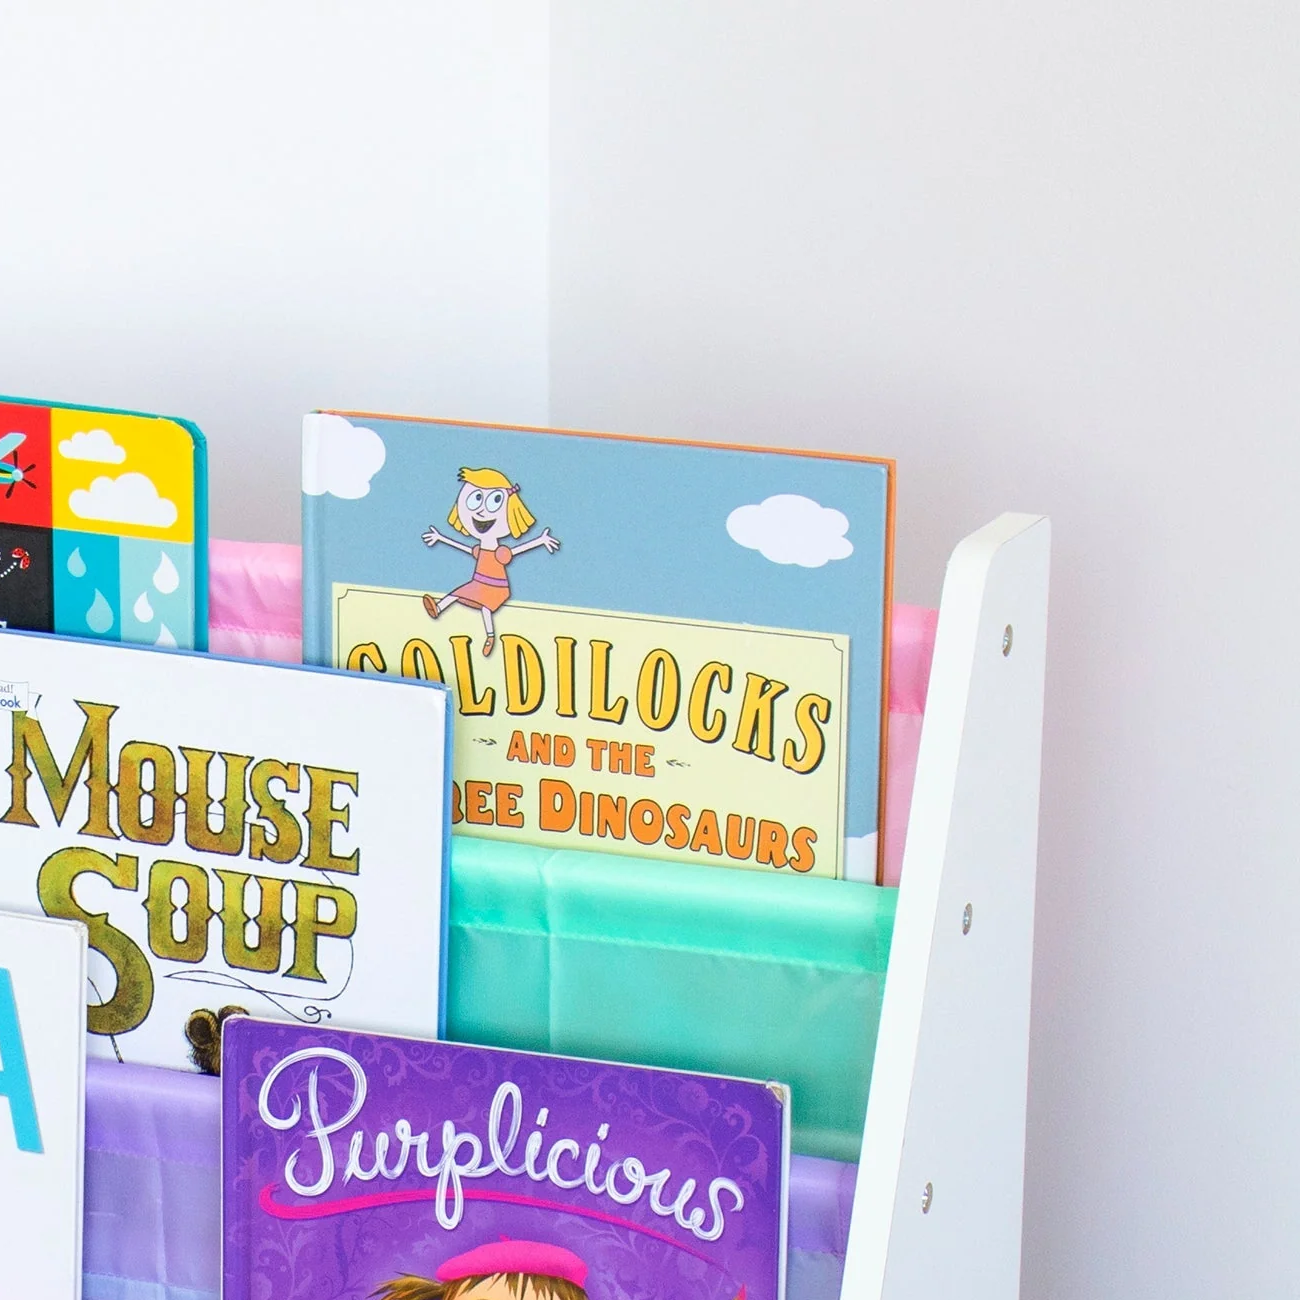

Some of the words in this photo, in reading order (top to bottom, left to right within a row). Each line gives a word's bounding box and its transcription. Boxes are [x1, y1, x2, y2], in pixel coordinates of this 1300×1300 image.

[0, 695, 360, 876] MOUSE
[506, 730, 576, 768] AND
[586, 738, 656, 778] THE
[539, 778, 818, 873] DINOSAURS
[36, 845, 358, 1036] SOUP
[258, 1046, 745, 1241] Purplicious
